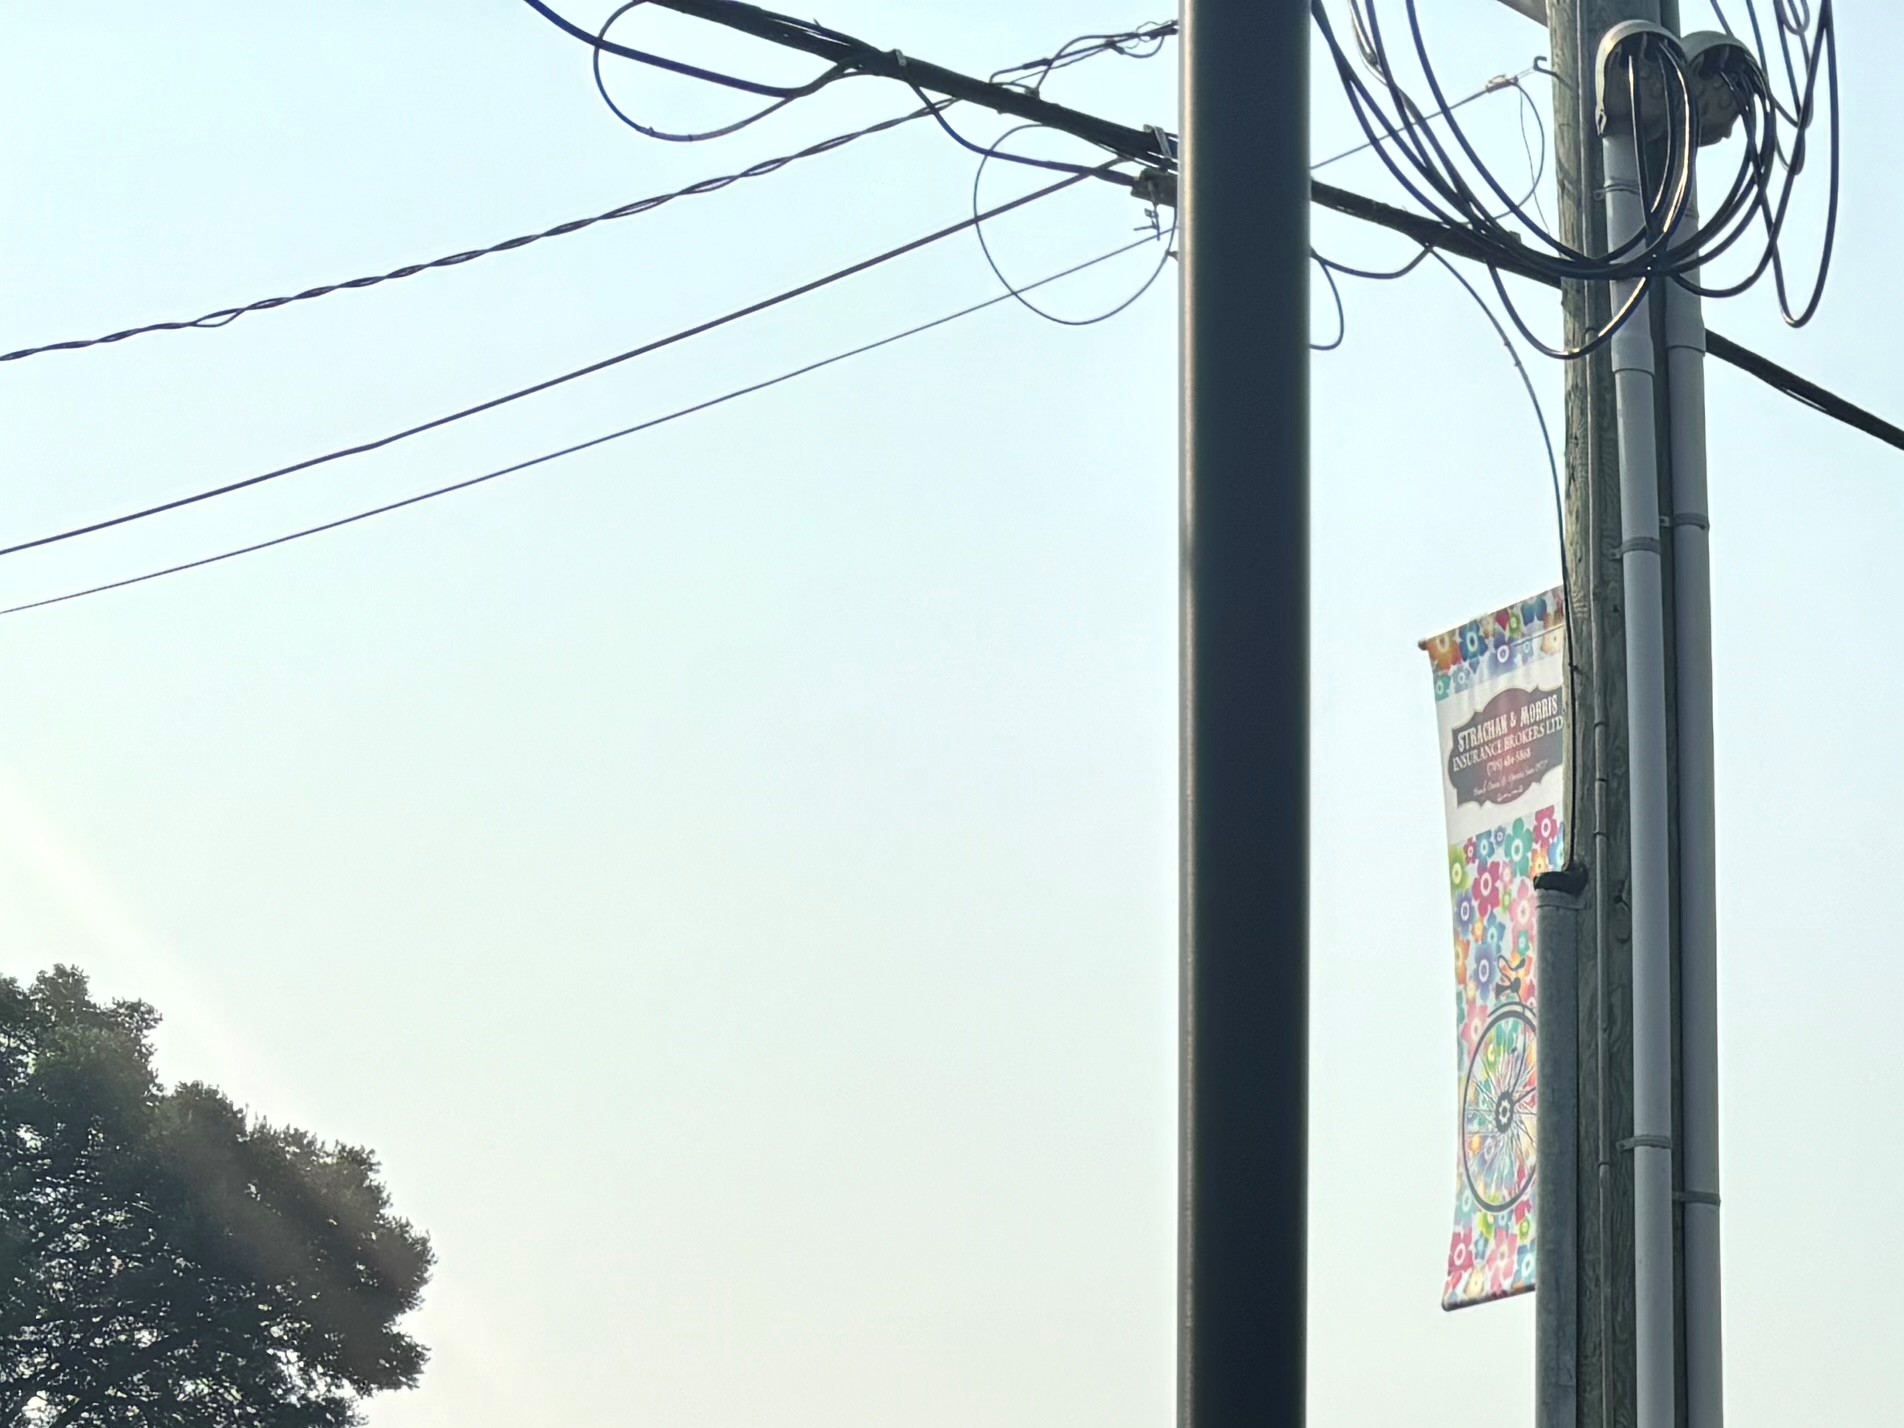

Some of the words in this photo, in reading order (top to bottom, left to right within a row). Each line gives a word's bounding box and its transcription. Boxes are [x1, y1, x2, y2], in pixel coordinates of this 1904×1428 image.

[1453, 740, 1501, 772] INSURANCE
[1504, 725, 1545, 752] BROKERS
[1457, 714, 1508, 752] STRACHAN
[1520, 694, 1558, 727] MORRIS
